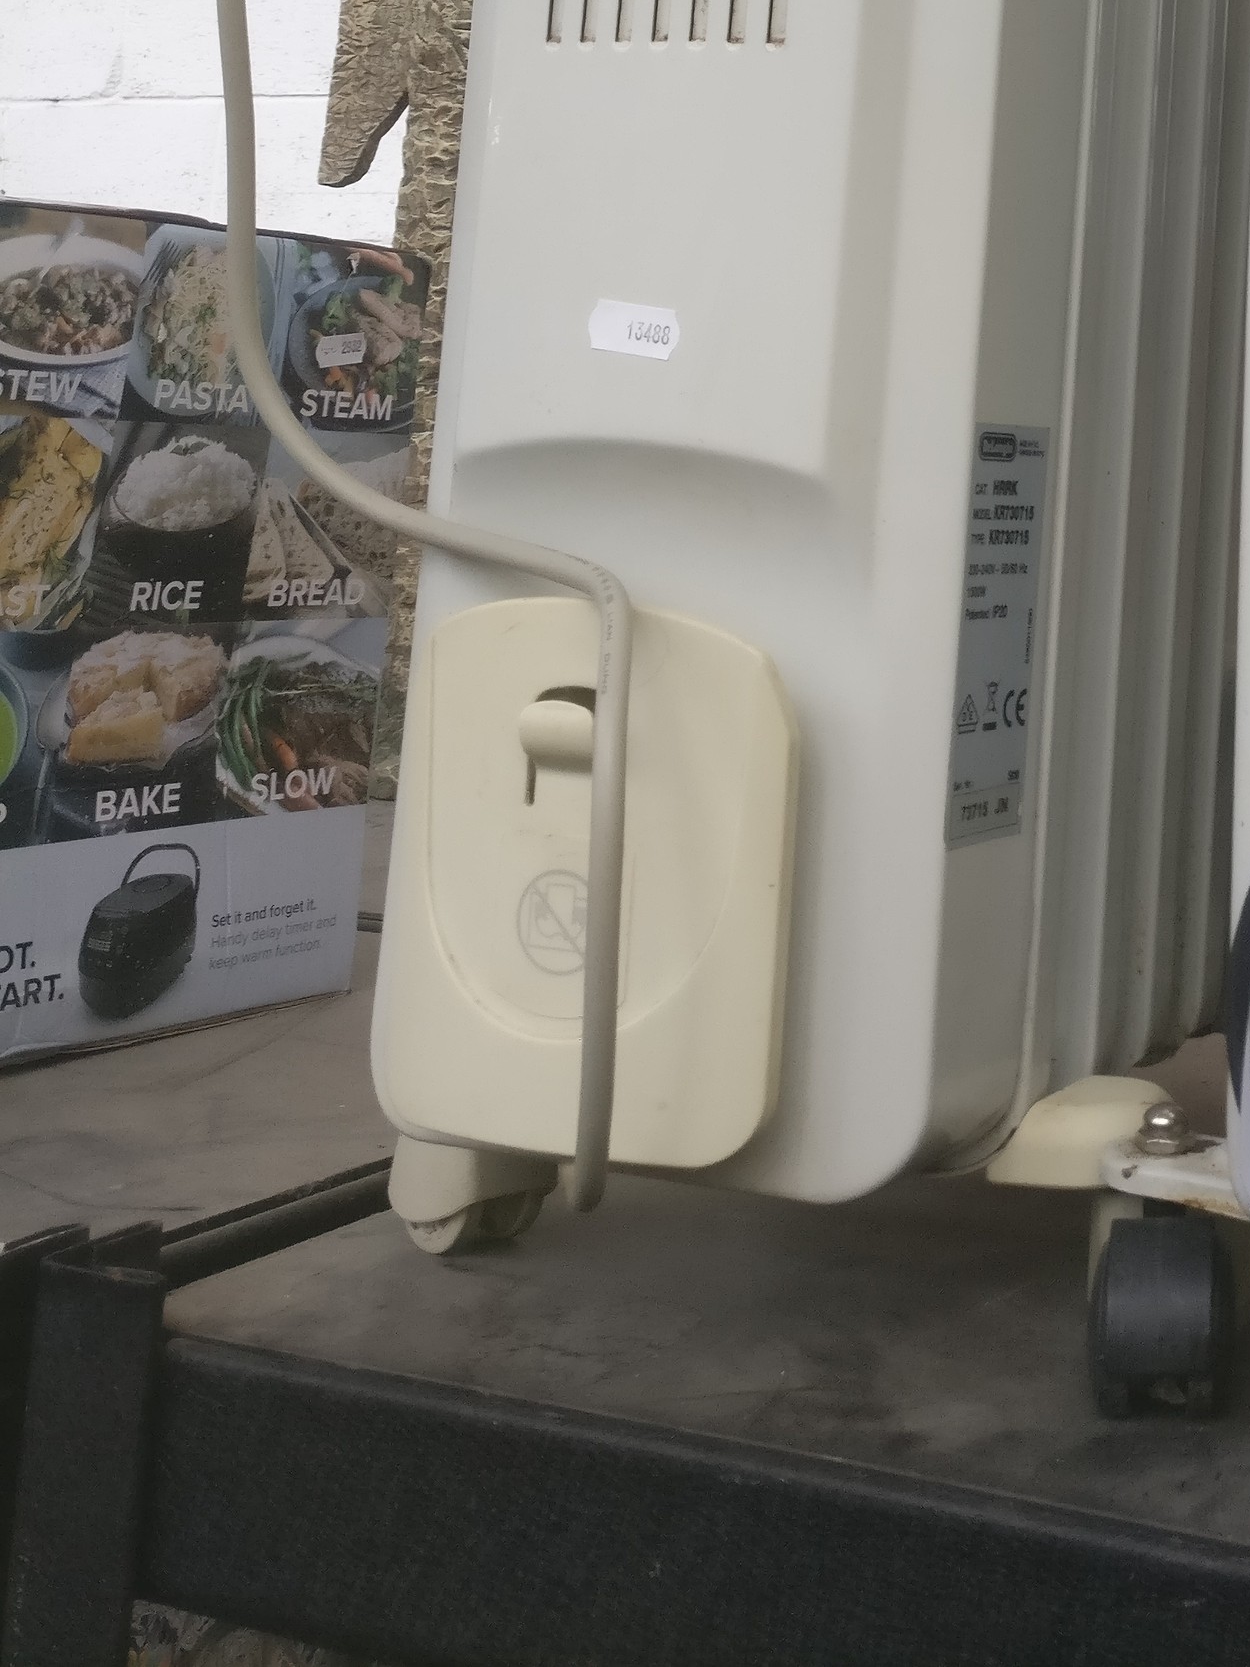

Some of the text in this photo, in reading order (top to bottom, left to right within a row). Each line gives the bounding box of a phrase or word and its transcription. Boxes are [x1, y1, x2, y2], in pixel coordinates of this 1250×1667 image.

[626, 320, 671, 346] 13488
[153, 380, 249, 413] PASTA
[300, 389, 394, 421] STEAM
[0, 585, 51, 617] ST
[129, 580, 205, 612] RICE
[267, 579, 366, 608] BREAD
[250, 767, 337, 803] SLOW
[95, 782, 183, 822] BAKE
[211, 913, 232, 927] Set
[244, 905, 268, 923] and
[269, 900, 305, 918] forget
[208, 955, 239, 971] keep
[0, 974, 64, 1012] ART.
